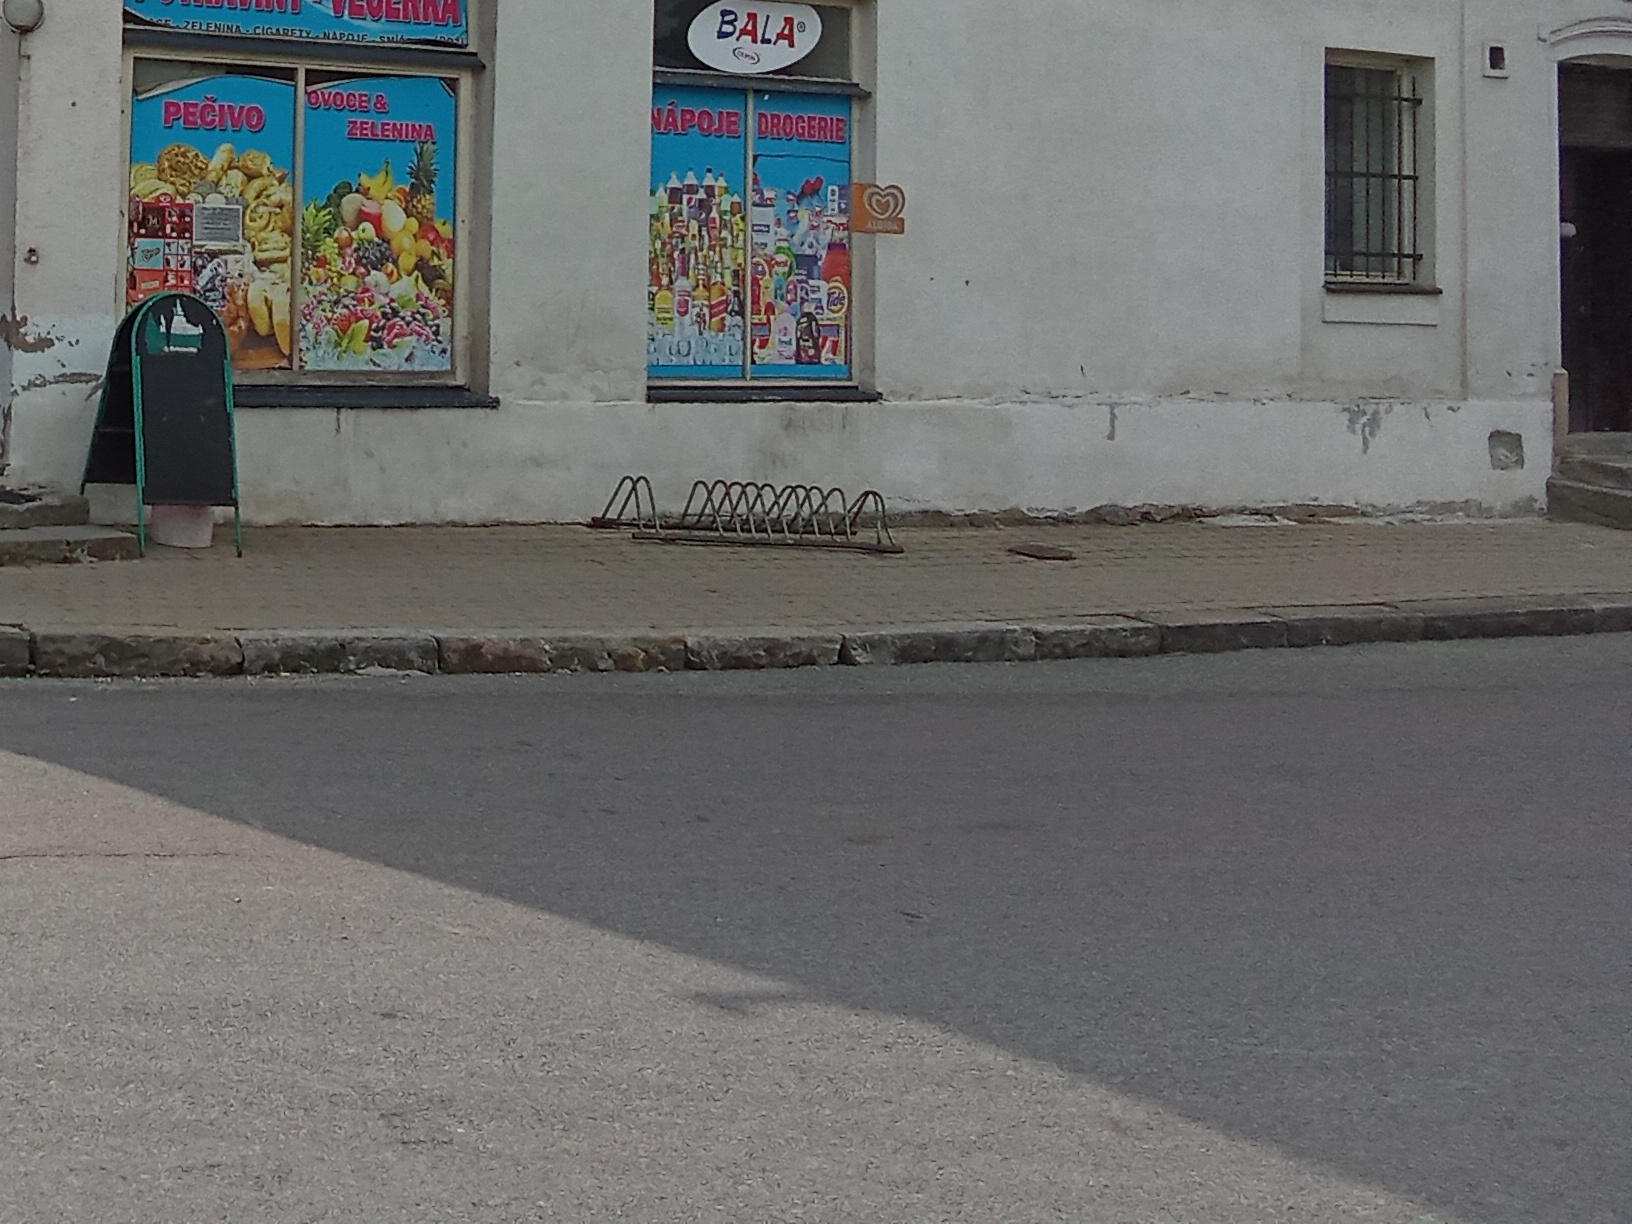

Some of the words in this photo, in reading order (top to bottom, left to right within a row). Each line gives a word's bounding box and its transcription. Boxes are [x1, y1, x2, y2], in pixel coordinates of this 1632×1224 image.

[183, 20, 242, 34] ZELENINA
[163, 95, 265, 132] PEČIVO
[306, 90, 370, 113] OVOCE
[373, 93, 389, 114] &
[347, 119, 437, 143] ZELENINA
[651, 100, 741, 137] NÁPOJE
[757, 111, 848, 143] DROGERIE
